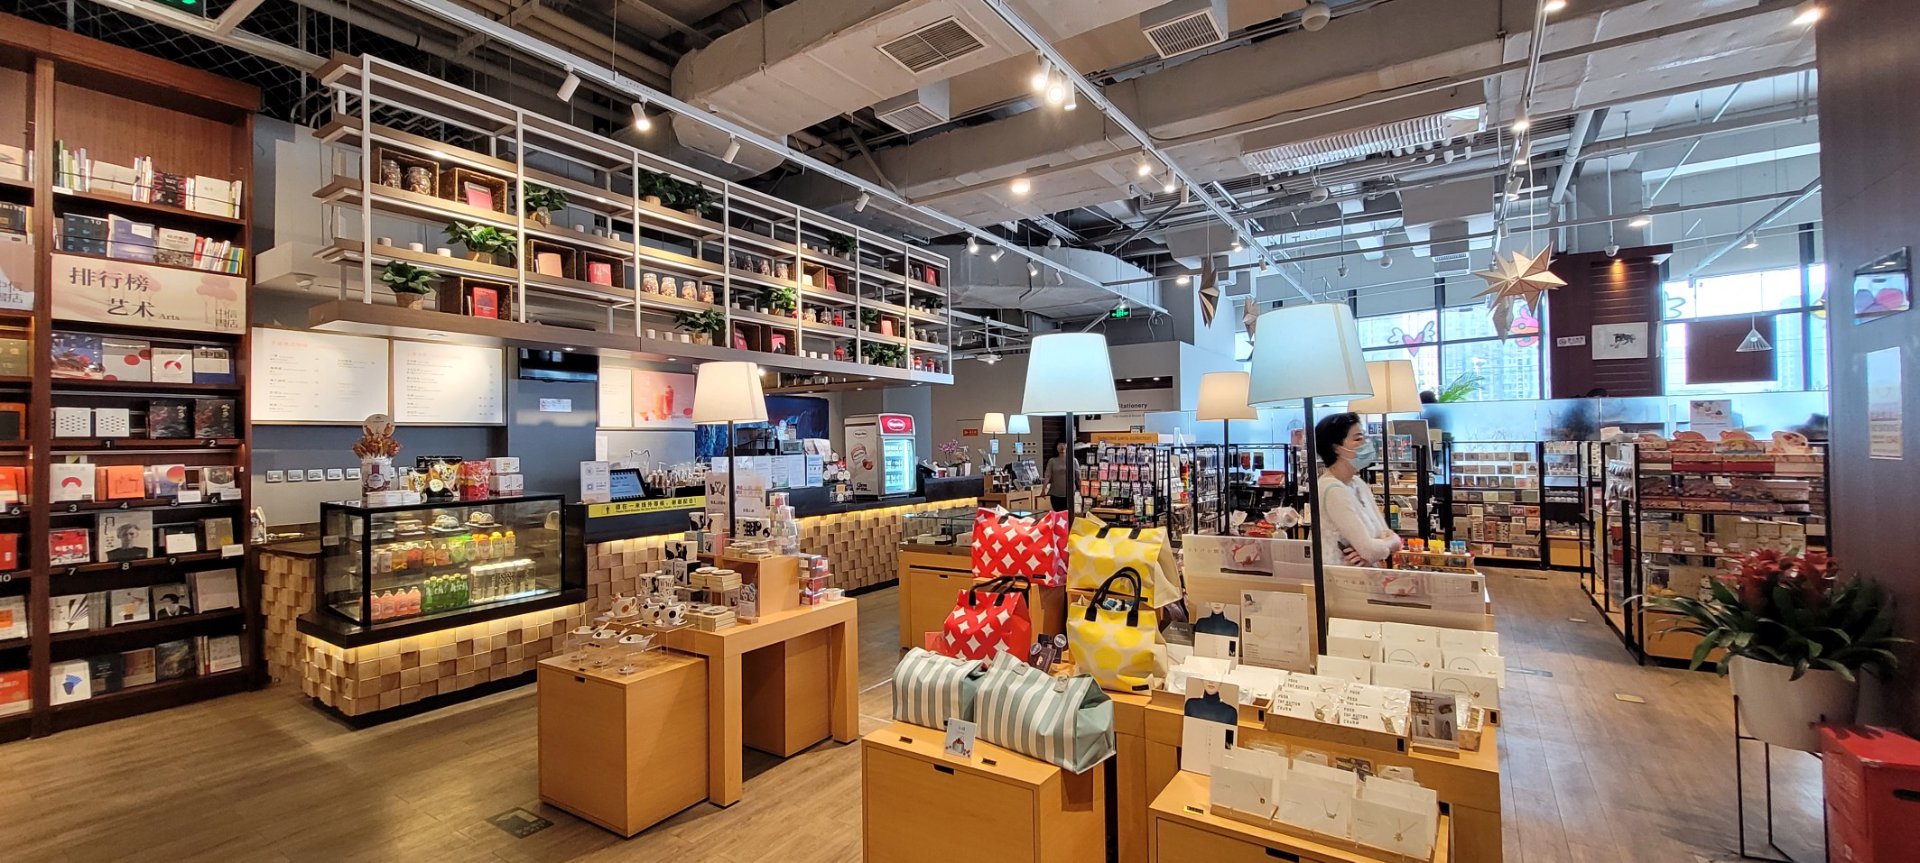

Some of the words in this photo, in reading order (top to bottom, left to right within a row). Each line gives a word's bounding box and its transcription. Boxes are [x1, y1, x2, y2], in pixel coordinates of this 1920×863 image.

[69, 266, 150, 292] 排行榜
[105, 298, 156, 319] 艺术
[159, 313, 181, 321] Arts
[105, 440, 112, 449] 1
[208, 439, 216, 448] 2
[170, 498, 178, 507] 5
[210, 496, 218, 504] 6
[69, 503, 78, 513] 3
[119, 501, 129, 509] 4
[11, 507, 20, 516] 6
[169, 557, 177, 566] 9
[121, 562, 130, 571] 8
[68, 567, 77, 577] 7
[0, 573, 12, 583] 10
